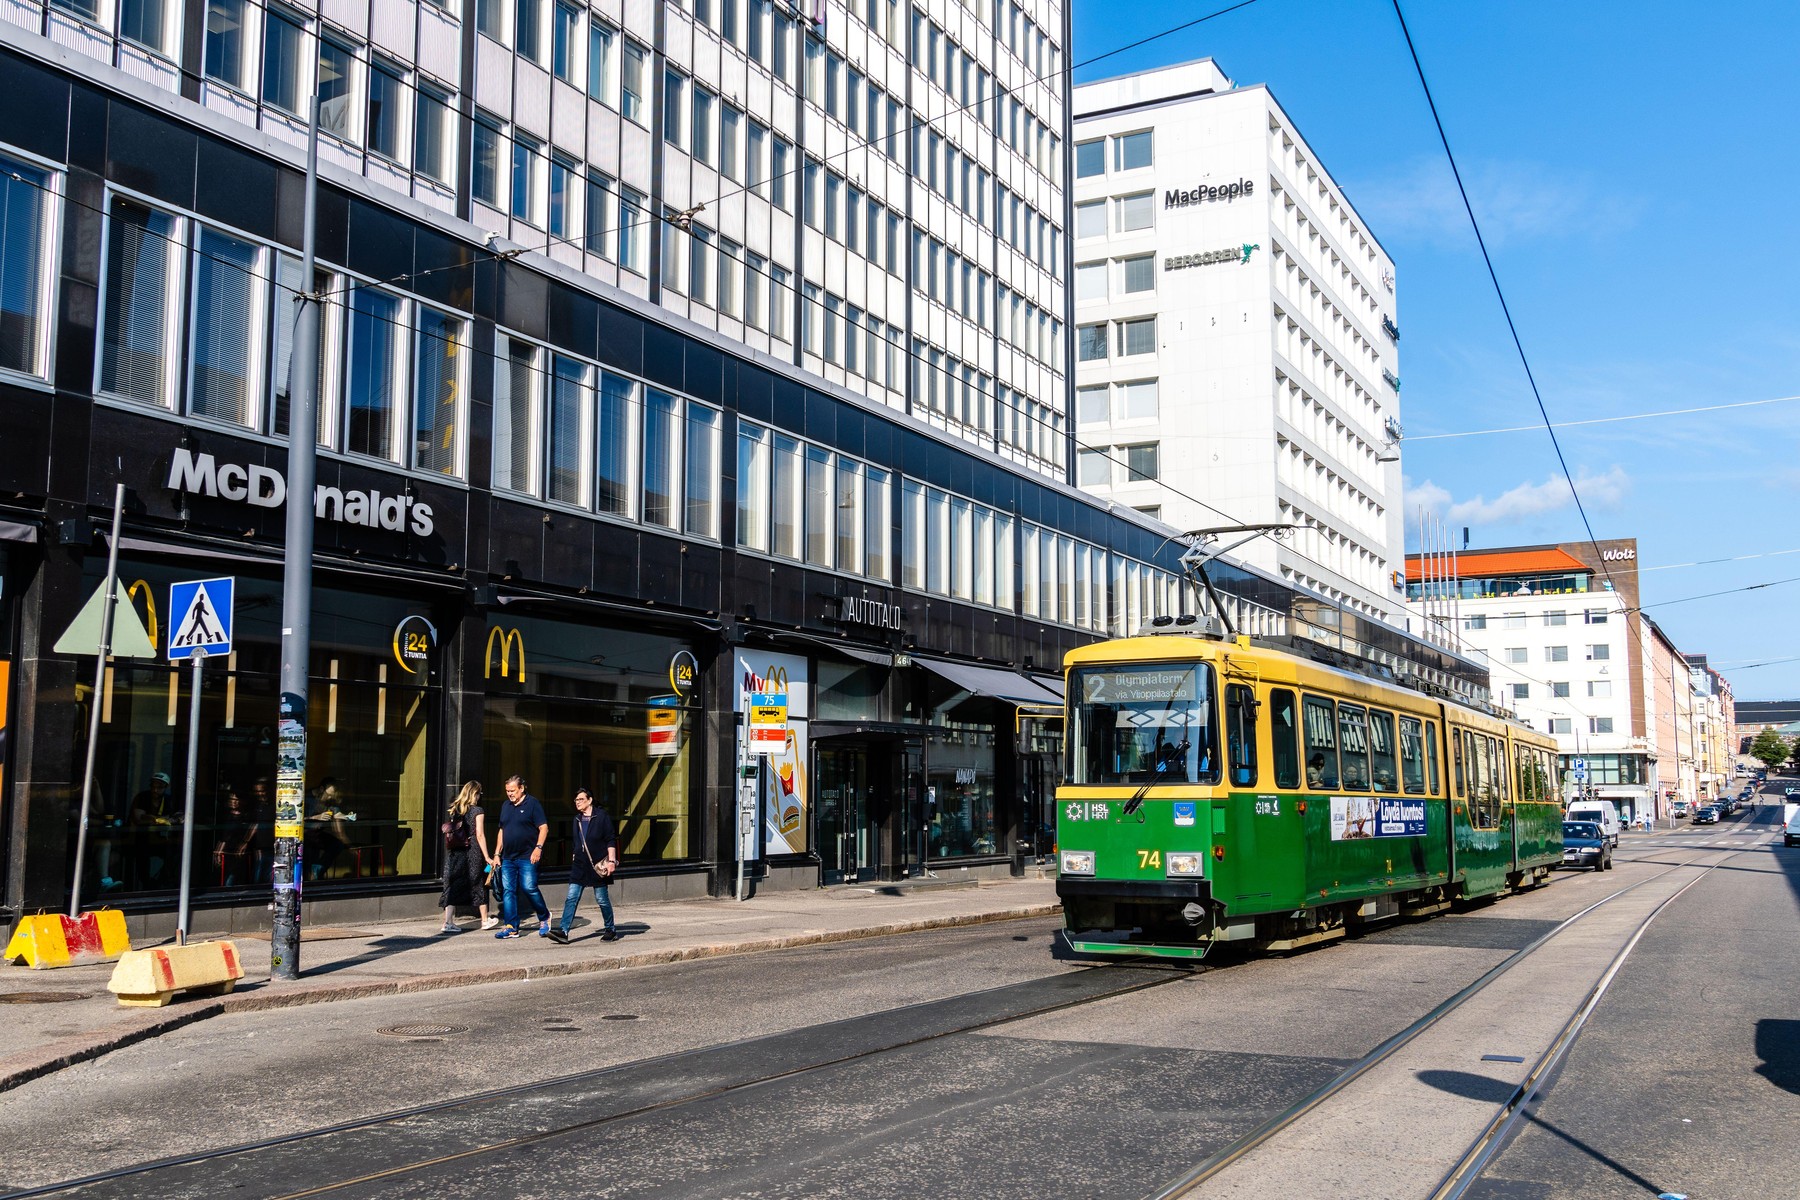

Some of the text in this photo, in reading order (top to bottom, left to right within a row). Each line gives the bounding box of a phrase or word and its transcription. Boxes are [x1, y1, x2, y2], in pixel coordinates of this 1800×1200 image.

[1165, 177, 1254, 206] MacPeople
[1165, 247, 1241, 271] BERGGREN
[168, 447, 434, 537] McDnald's
[1603, 548, 1635, 561] Wolt
[848, 596, 900, 630] AUTOTALO
[408, 633, 428, 652] 24
[680, 664, 692, 680] 24
[1088, 675, 1106, 702] 2
[1115, 690, 1128, 699] via
[764, 695, 775, 706] 75
[1575, 759, 1583, 769] P
[1092, 803, 1109, 812] HSL
[1092, 811, 1109, 820] HRT
[1381, 801, 1424, 824] Löydä luontosi
[1137, 850, 1161, 868] 74
